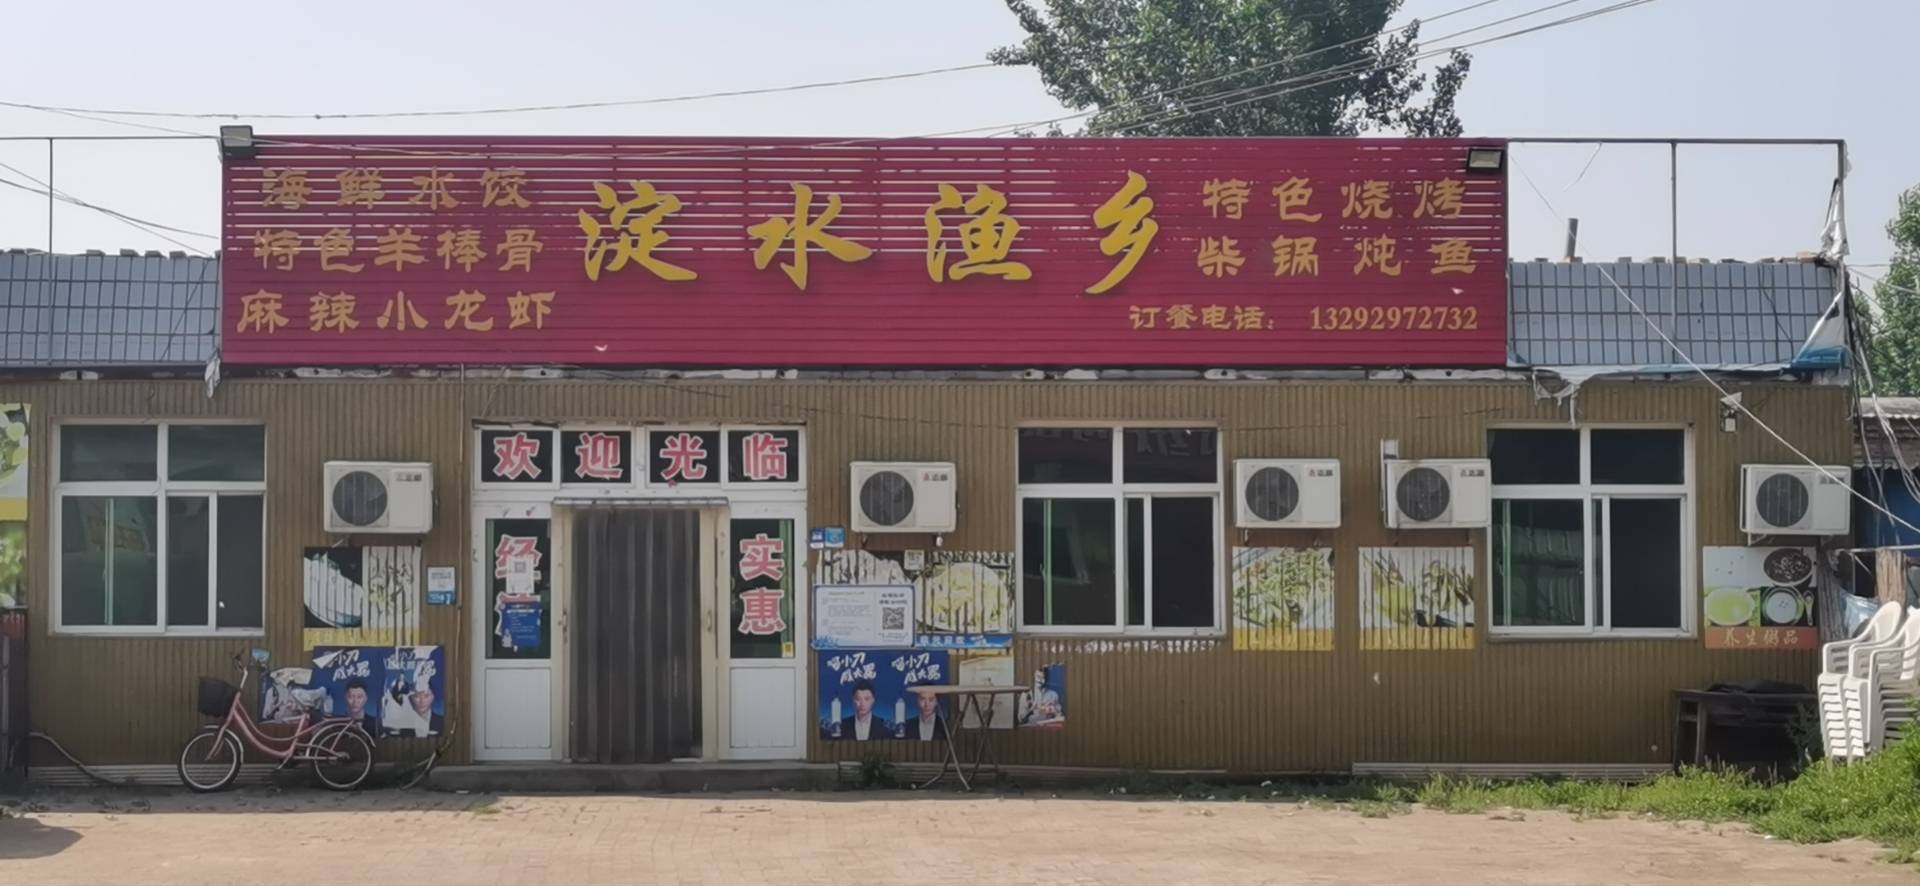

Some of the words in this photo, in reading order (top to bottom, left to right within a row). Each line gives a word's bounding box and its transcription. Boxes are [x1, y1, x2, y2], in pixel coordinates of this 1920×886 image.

[261, 166, 532, 211] 海鲜水饺
[1202, 176, 1466, 223] 特色烧烤
[253, 227, 545, 273] 特色羊棒骨
[577, 171, 1159, 295] 淀水渔乡
[1197, 233, 1477, 278] 柴锅炖鱼
[236, 288, 556, 334] 麻辣小龙虾
[1310, 305, 1478, 330] 13292972732
[493, 432, 788, 480] 欢迎光临
[738, 533, 786, 635] 实惠
